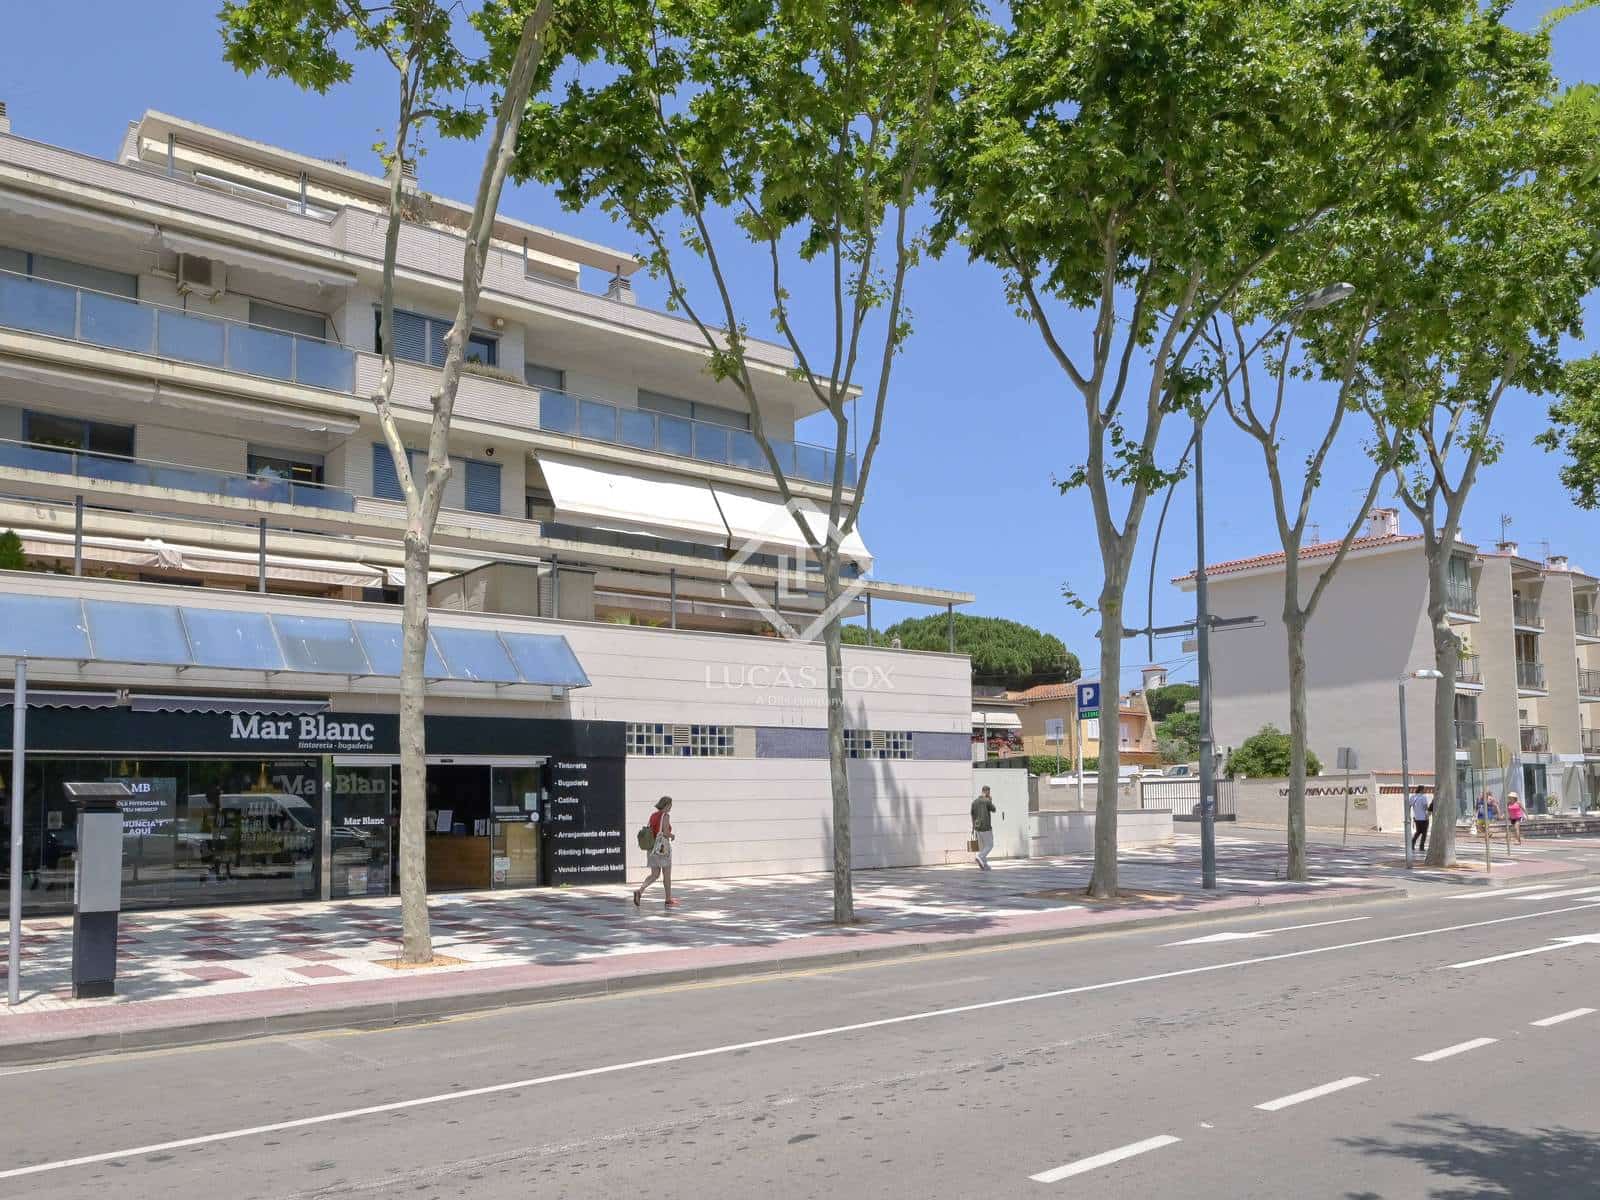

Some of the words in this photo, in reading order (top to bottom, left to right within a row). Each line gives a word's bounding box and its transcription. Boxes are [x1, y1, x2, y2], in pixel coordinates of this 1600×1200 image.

[1082, 687, 1095, 705] P
[230, 715, 292, 739] Mar
[299, 715, 375, 741] Blanc
[338, 741, 373, 750] bugaderia
[131, 783, 151, 792] MB
[343, 817, 360, 825] Mar
[362, 816, 385, 825] Blanc
